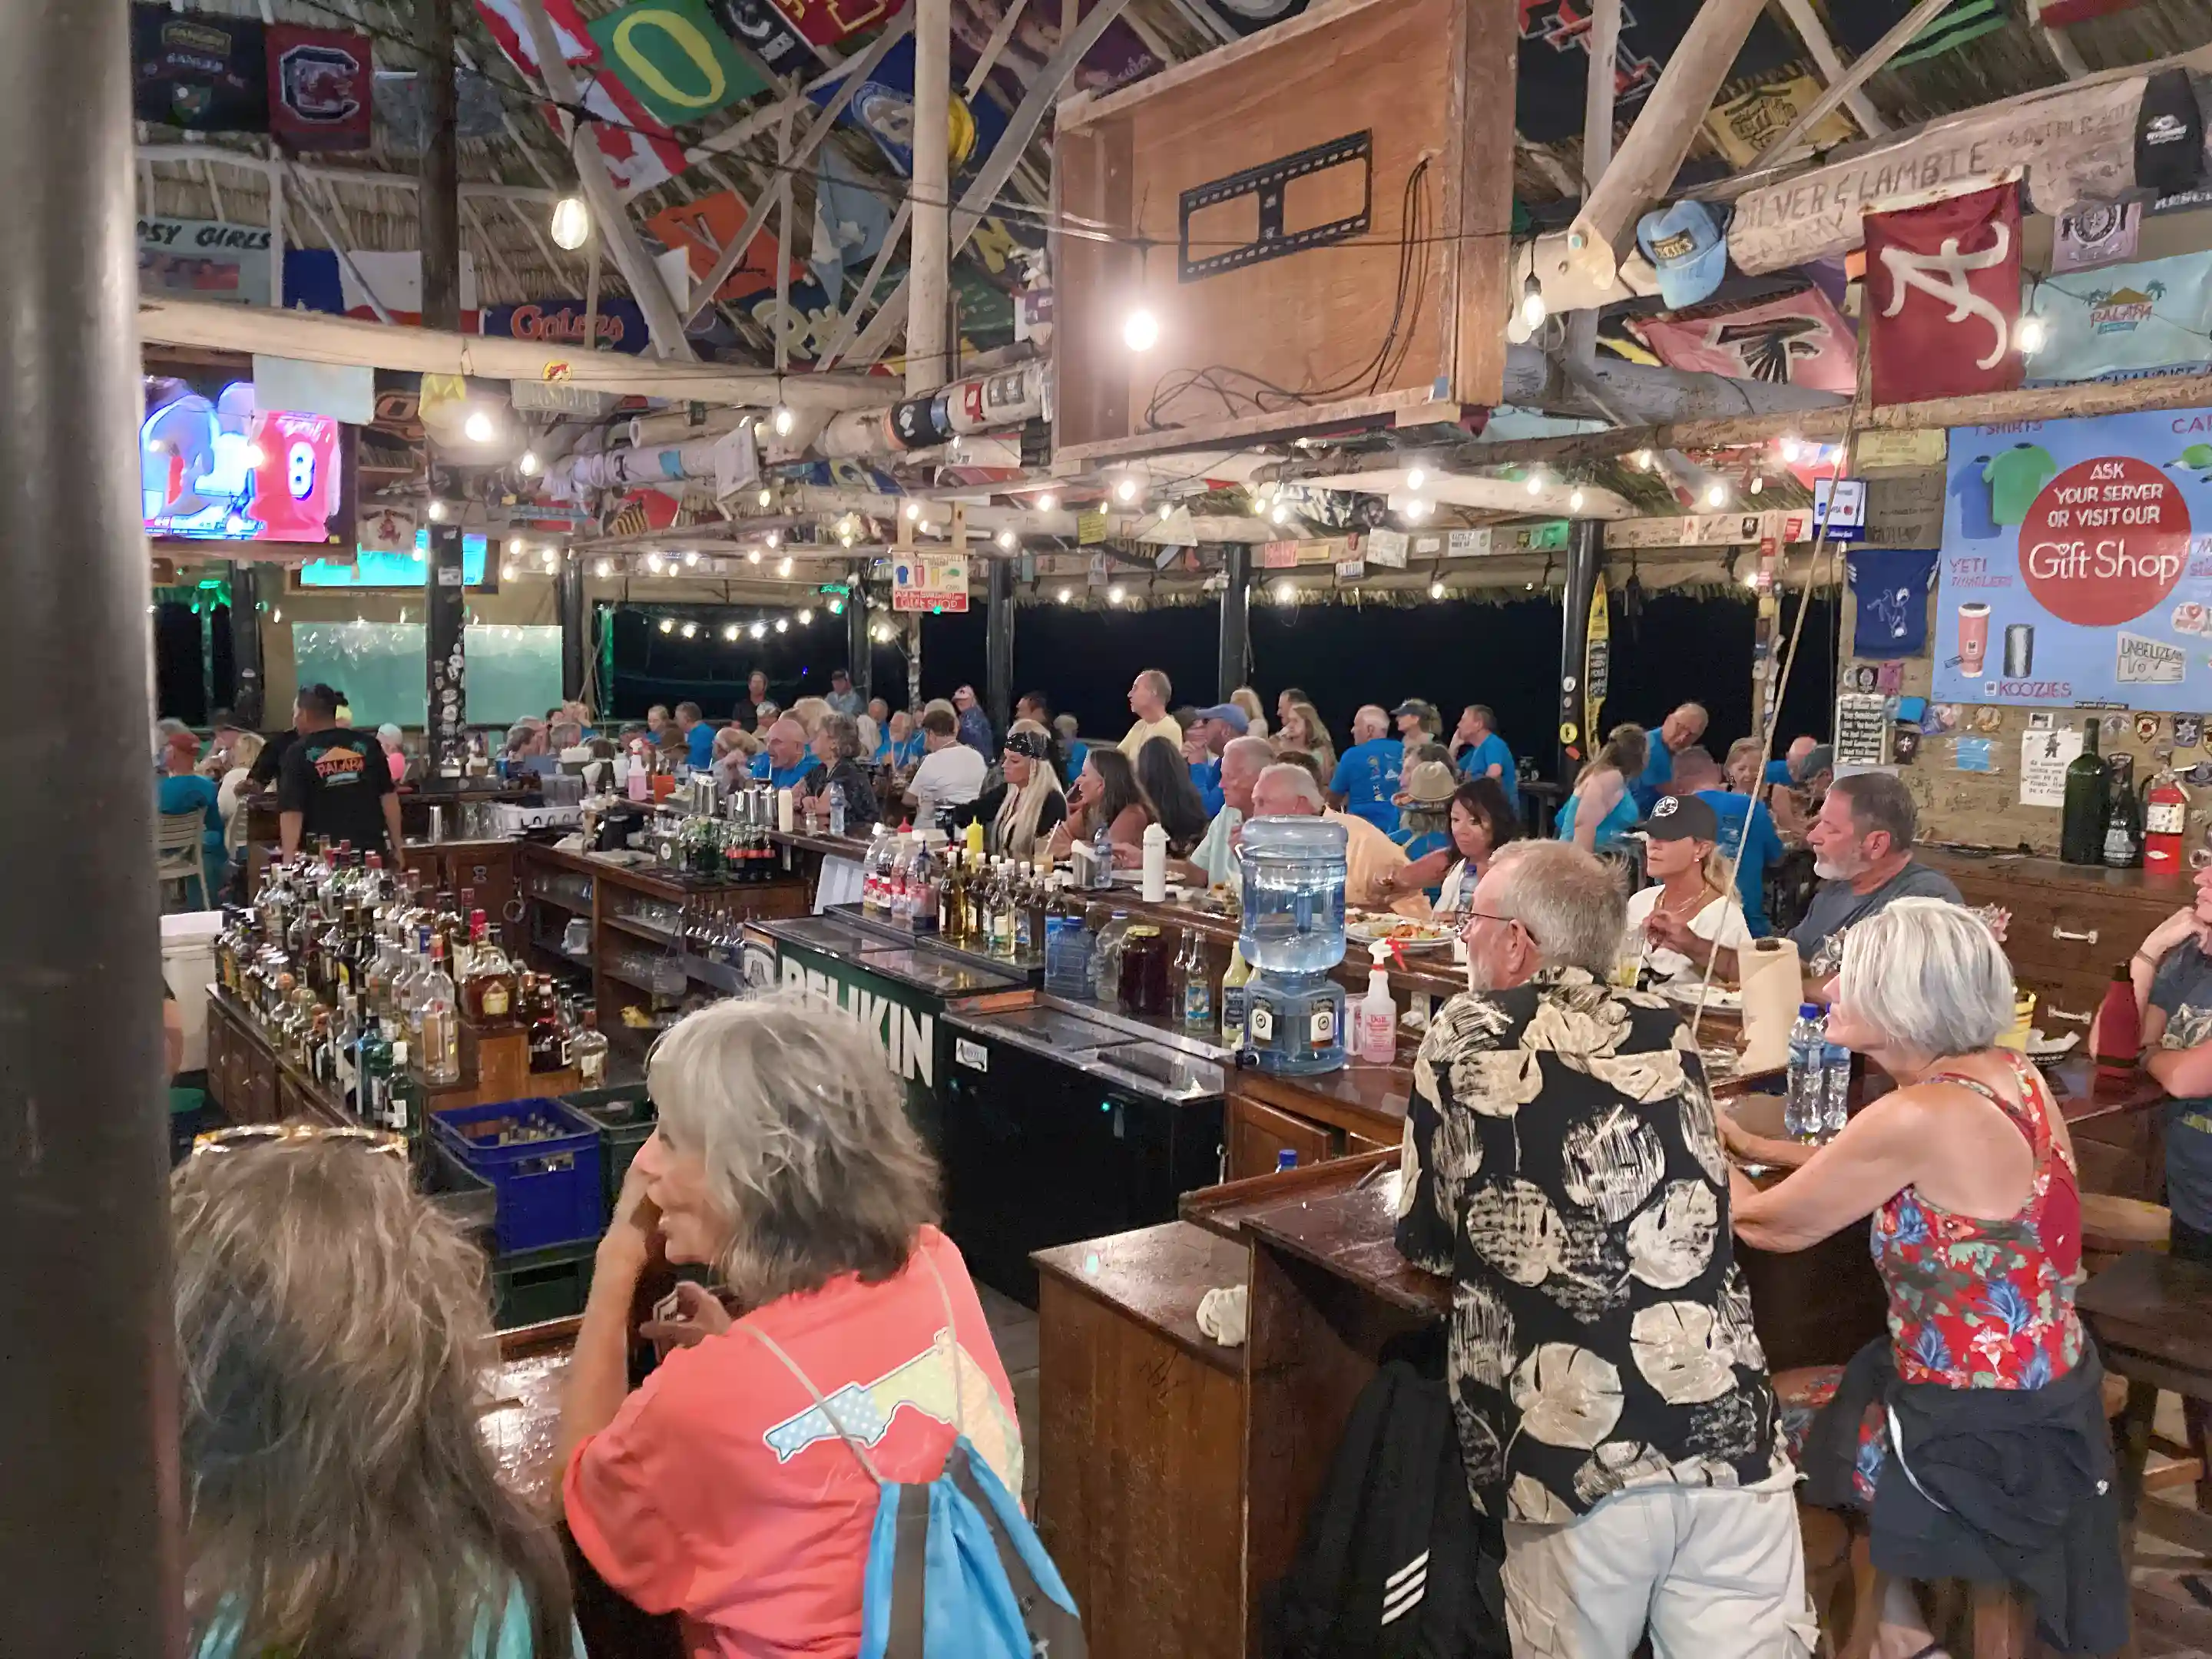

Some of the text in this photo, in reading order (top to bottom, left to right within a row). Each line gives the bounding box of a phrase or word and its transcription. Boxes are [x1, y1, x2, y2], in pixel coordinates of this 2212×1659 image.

[195, 225, 272, 250] GIRLS
[288, 441, 316, 502] 8
[2089, 462, 2125, 481] ASK
[2053, 482, 2164, 505] YOUR SERVER
[2047, 505, 2161, 528] OR VISIT OUR
[1949, 557, 1988, 575] YETI
[2028, 537, 2181, 586] Gift Shop
[1998, 680, 2072, 699] KOOZIES
